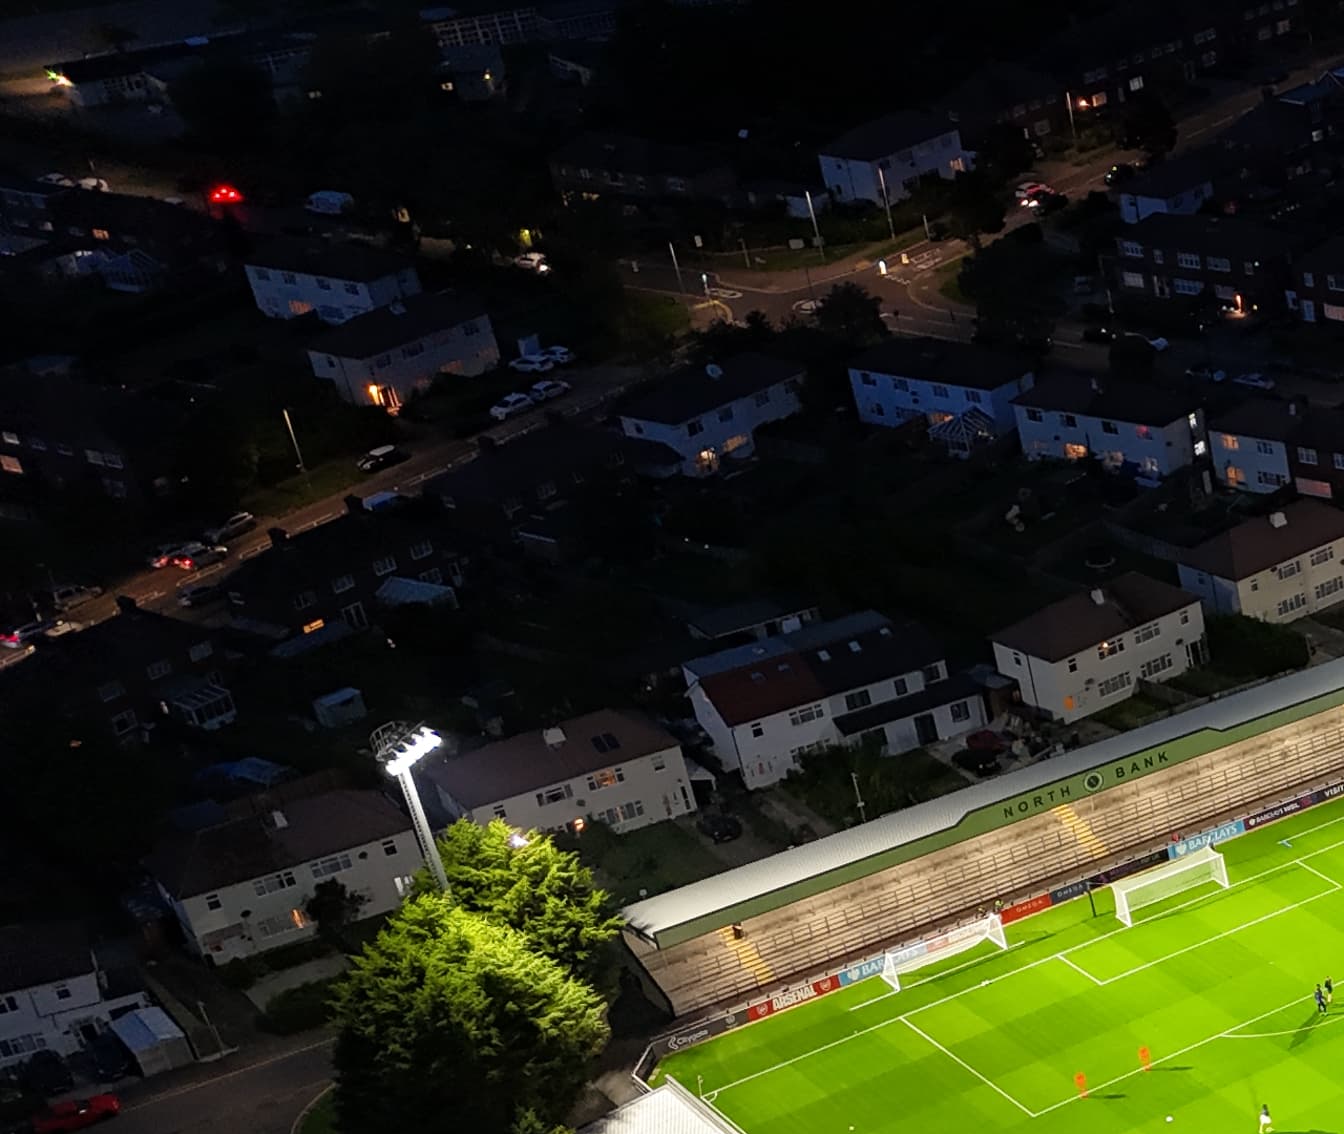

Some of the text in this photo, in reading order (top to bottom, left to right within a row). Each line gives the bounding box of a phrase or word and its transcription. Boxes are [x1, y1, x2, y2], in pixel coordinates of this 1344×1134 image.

[1003, 751, 1168, 819] NORTH BANK
[1324, 783, 1344, 798] VISIT
[1188, 824, 1237, 850] BARCLAYS
[1057, 883, 1083, 897] OMEGA
[773, 985, 817, 1011] ARSENAL
